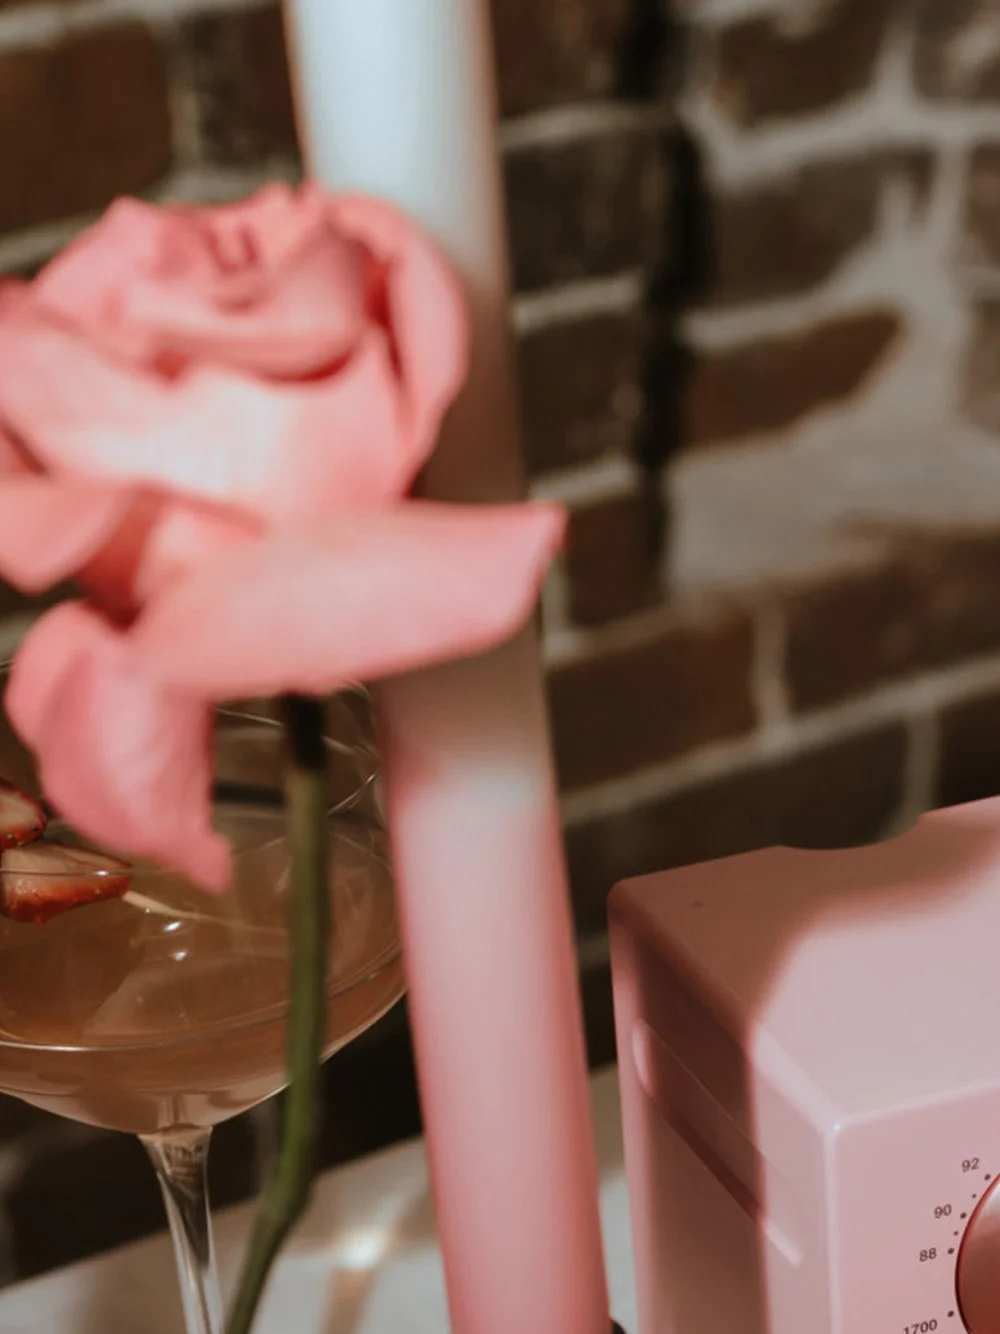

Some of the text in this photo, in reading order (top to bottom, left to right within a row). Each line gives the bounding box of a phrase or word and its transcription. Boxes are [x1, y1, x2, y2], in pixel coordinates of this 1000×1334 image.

[961, 1157, 980, 1173] 92
[933, 1203, 953, 1219] 90
[919, 1247, 937, 1263] 88
